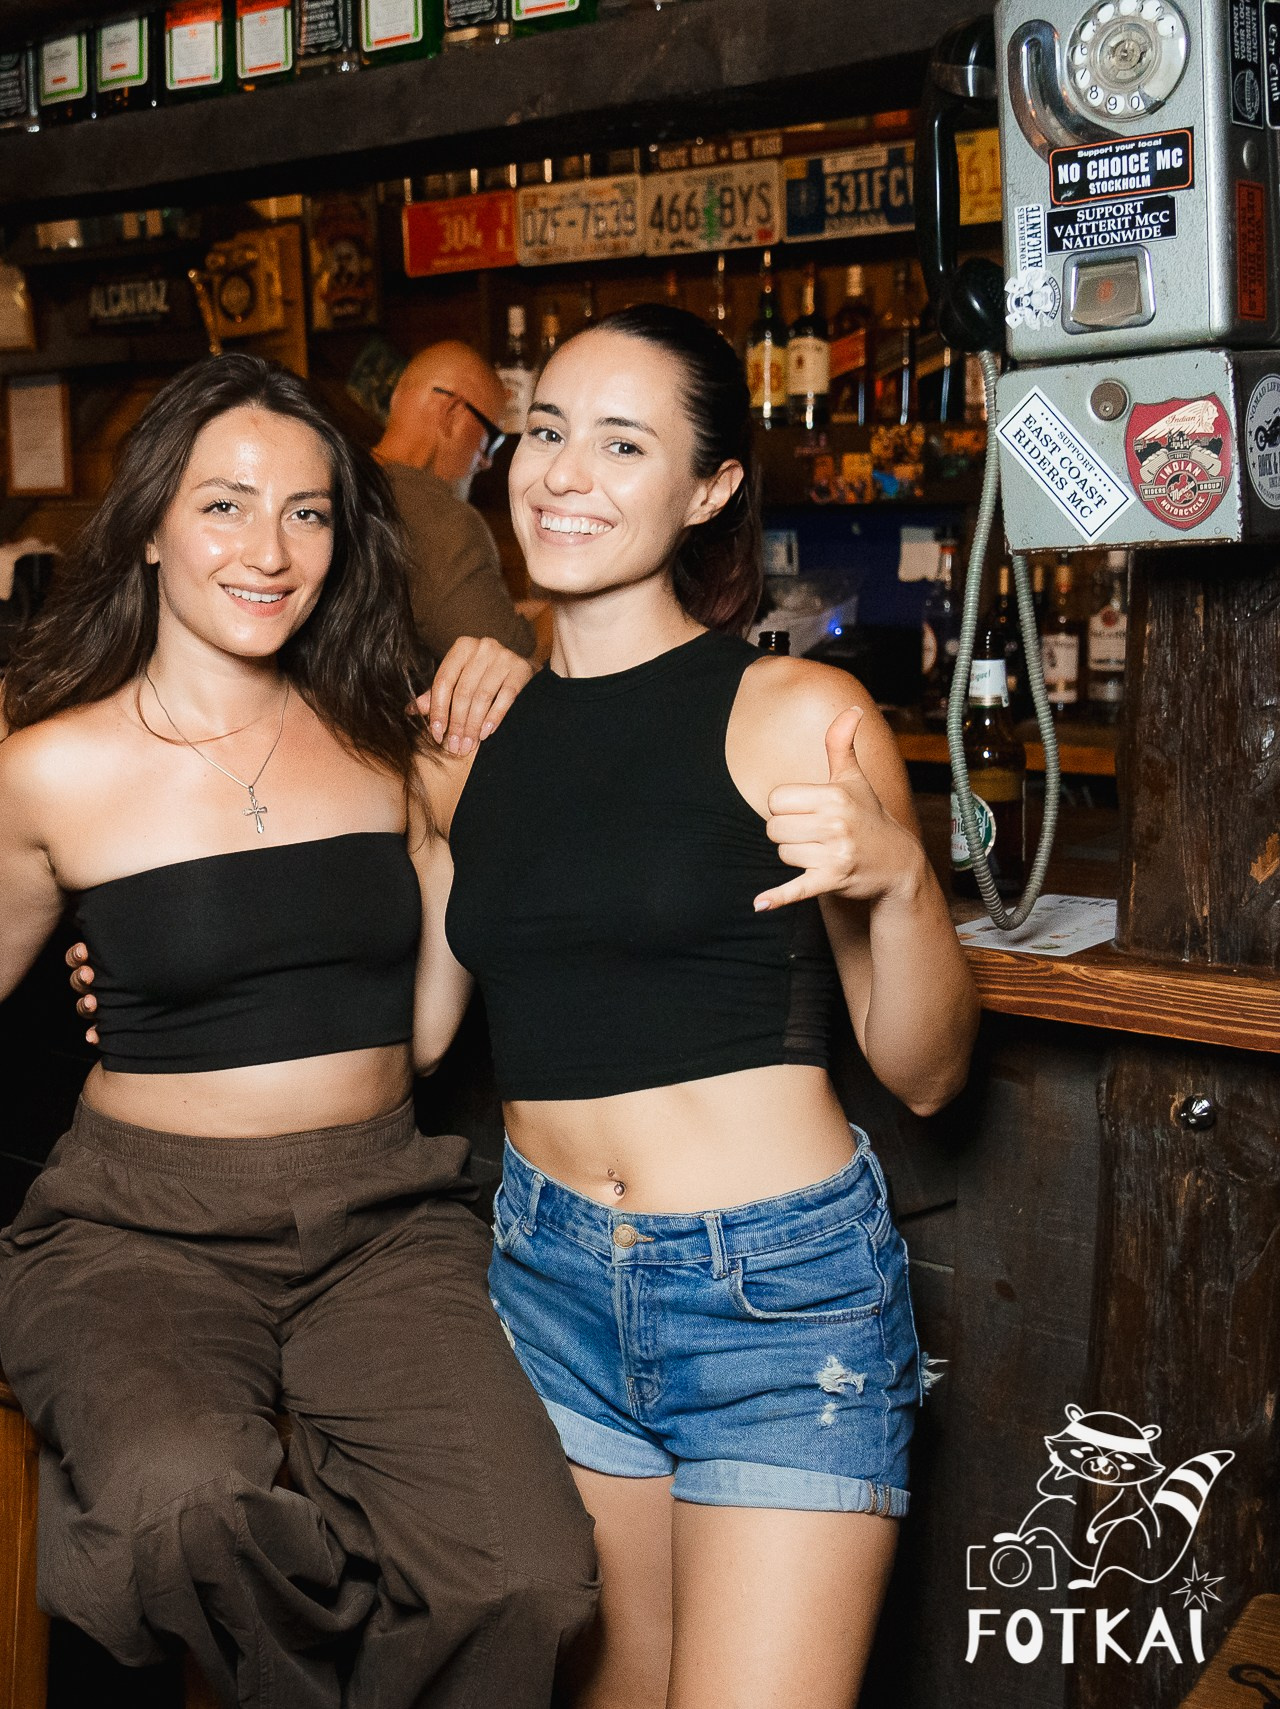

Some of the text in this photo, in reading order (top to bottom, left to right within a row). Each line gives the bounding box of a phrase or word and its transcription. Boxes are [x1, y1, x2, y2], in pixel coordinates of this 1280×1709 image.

[1233, 4, 1241, 59] SUPPORT
[1089, 85, 1099, 99] 8
[1107, 96, 1117, 110] 9
[1130, 95, 1140, 110] 0
[1077, 138, 1162, 158] Support your local
[1057, 147, 1183, 184] NO CHOICE MC
[1088, 174, 1151, 195] STOCKHOLM
[650, 191, 700, 235] 466
[1053, 210, 1170, 238] VAITTERIT MCC
[1076, 201, 1144, 222] SUPPORT
[1018, 207, 1027, 271] STONEBIKERS
[1026, 205, 1042, 268] ALICANTE
[1061, 225, 1162, 250] NATIONWIDE
[1022, 413, 1108, 509] EAST COAST
[1058, 431, 1096, 473] SUPPORT
[1012, 427, 1093, 519] RIDERS MC
[1159, 461, 1202, 480] INDIAN
[1144, 482, 1221, 496] RIDERS GROUP
[1160, 496, 1206, 517] MOTORCYCLE
